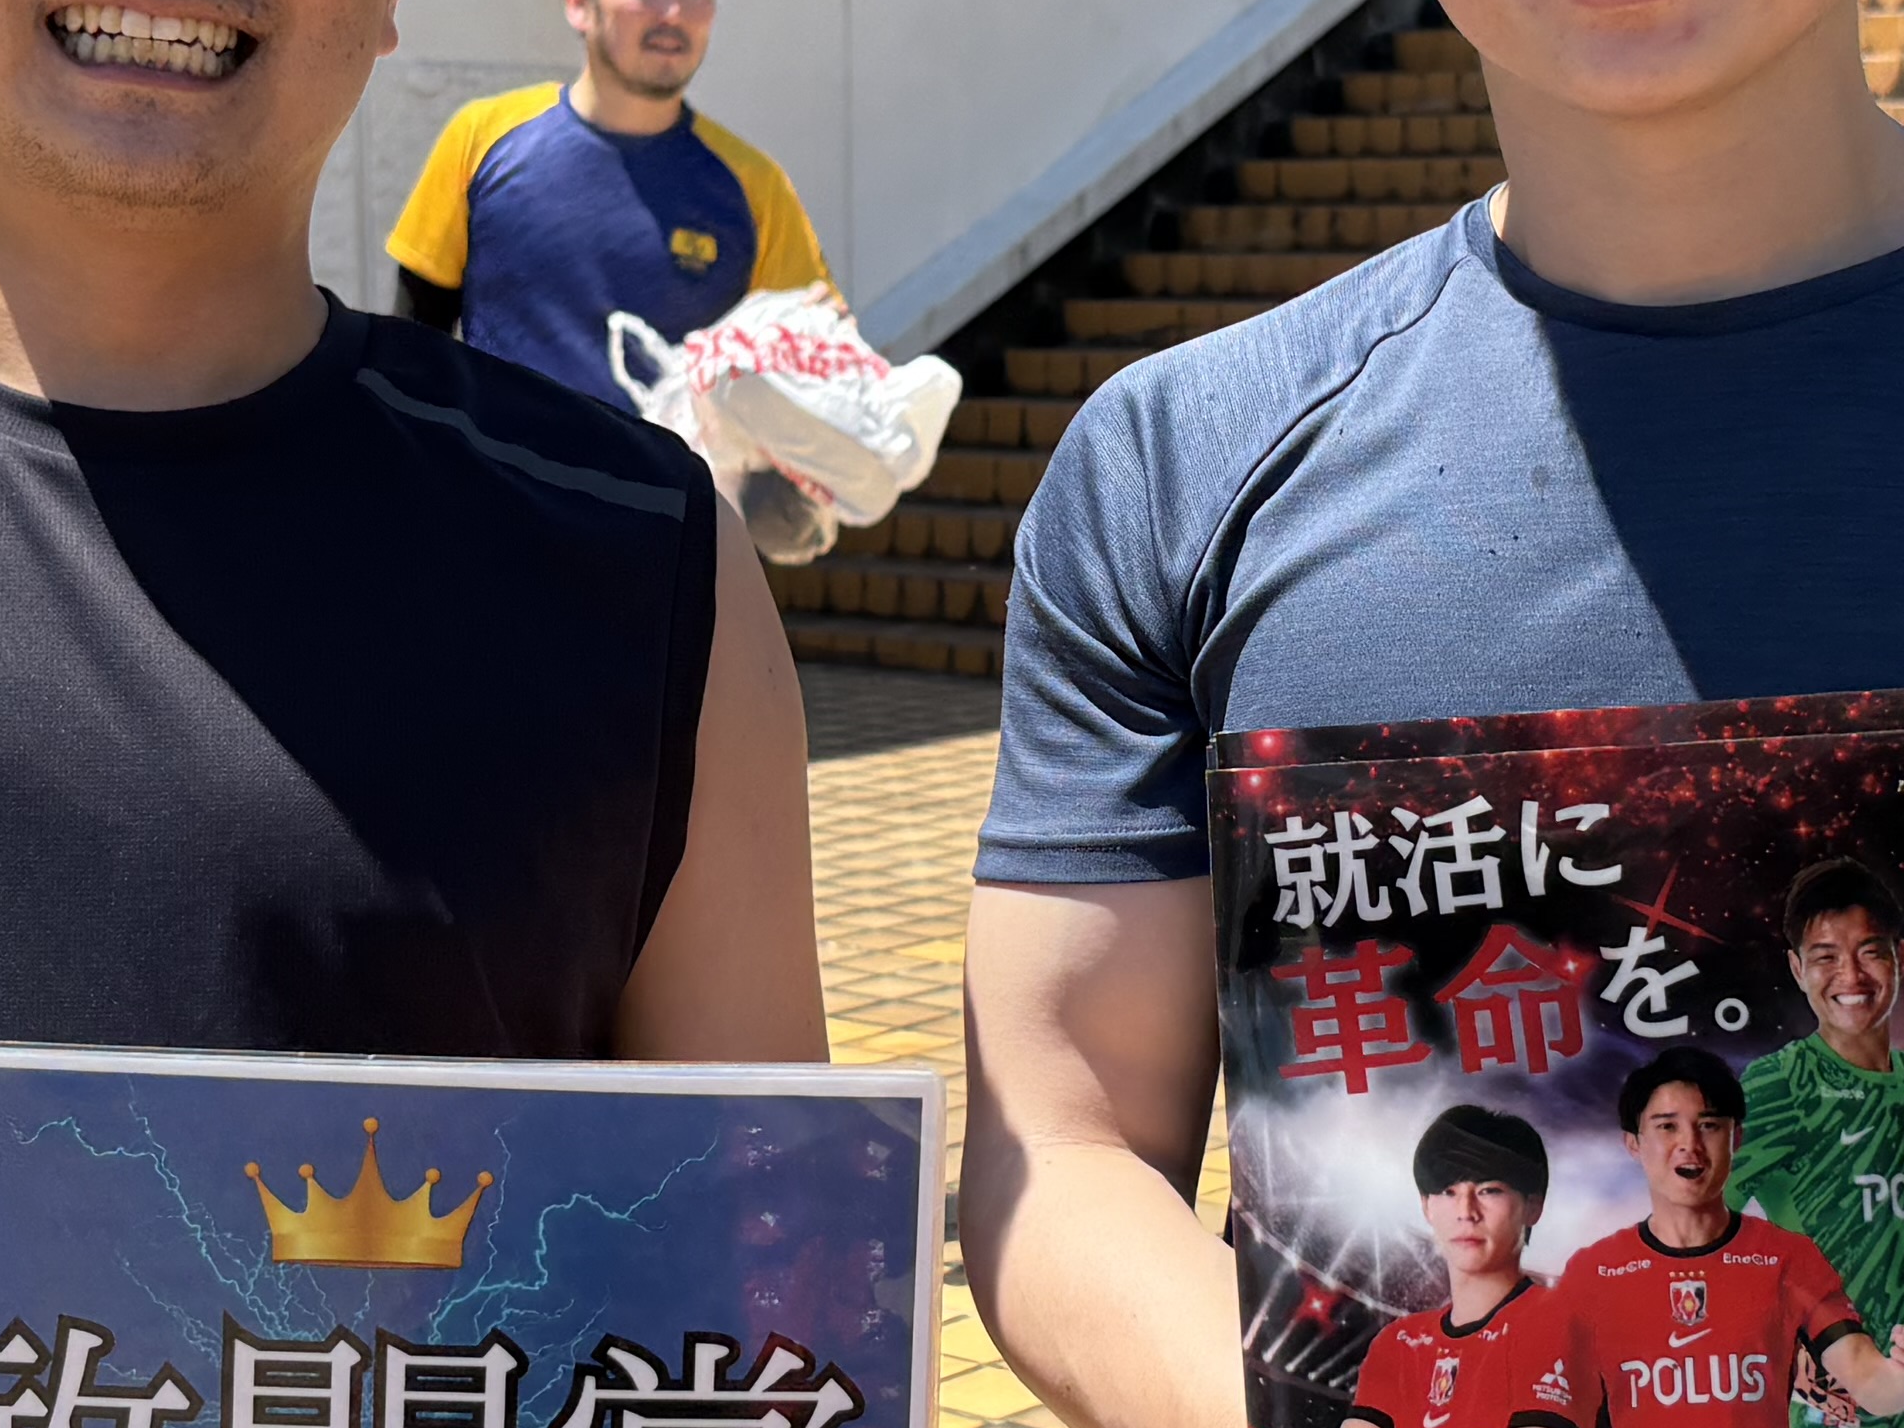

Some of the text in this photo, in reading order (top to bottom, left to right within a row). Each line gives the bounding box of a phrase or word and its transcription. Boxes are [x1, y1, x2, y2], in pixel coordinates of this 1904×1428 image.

[1264, 795, 1623, 930] 就活に
[1621, 1353, 1768, 1408] POLUS
